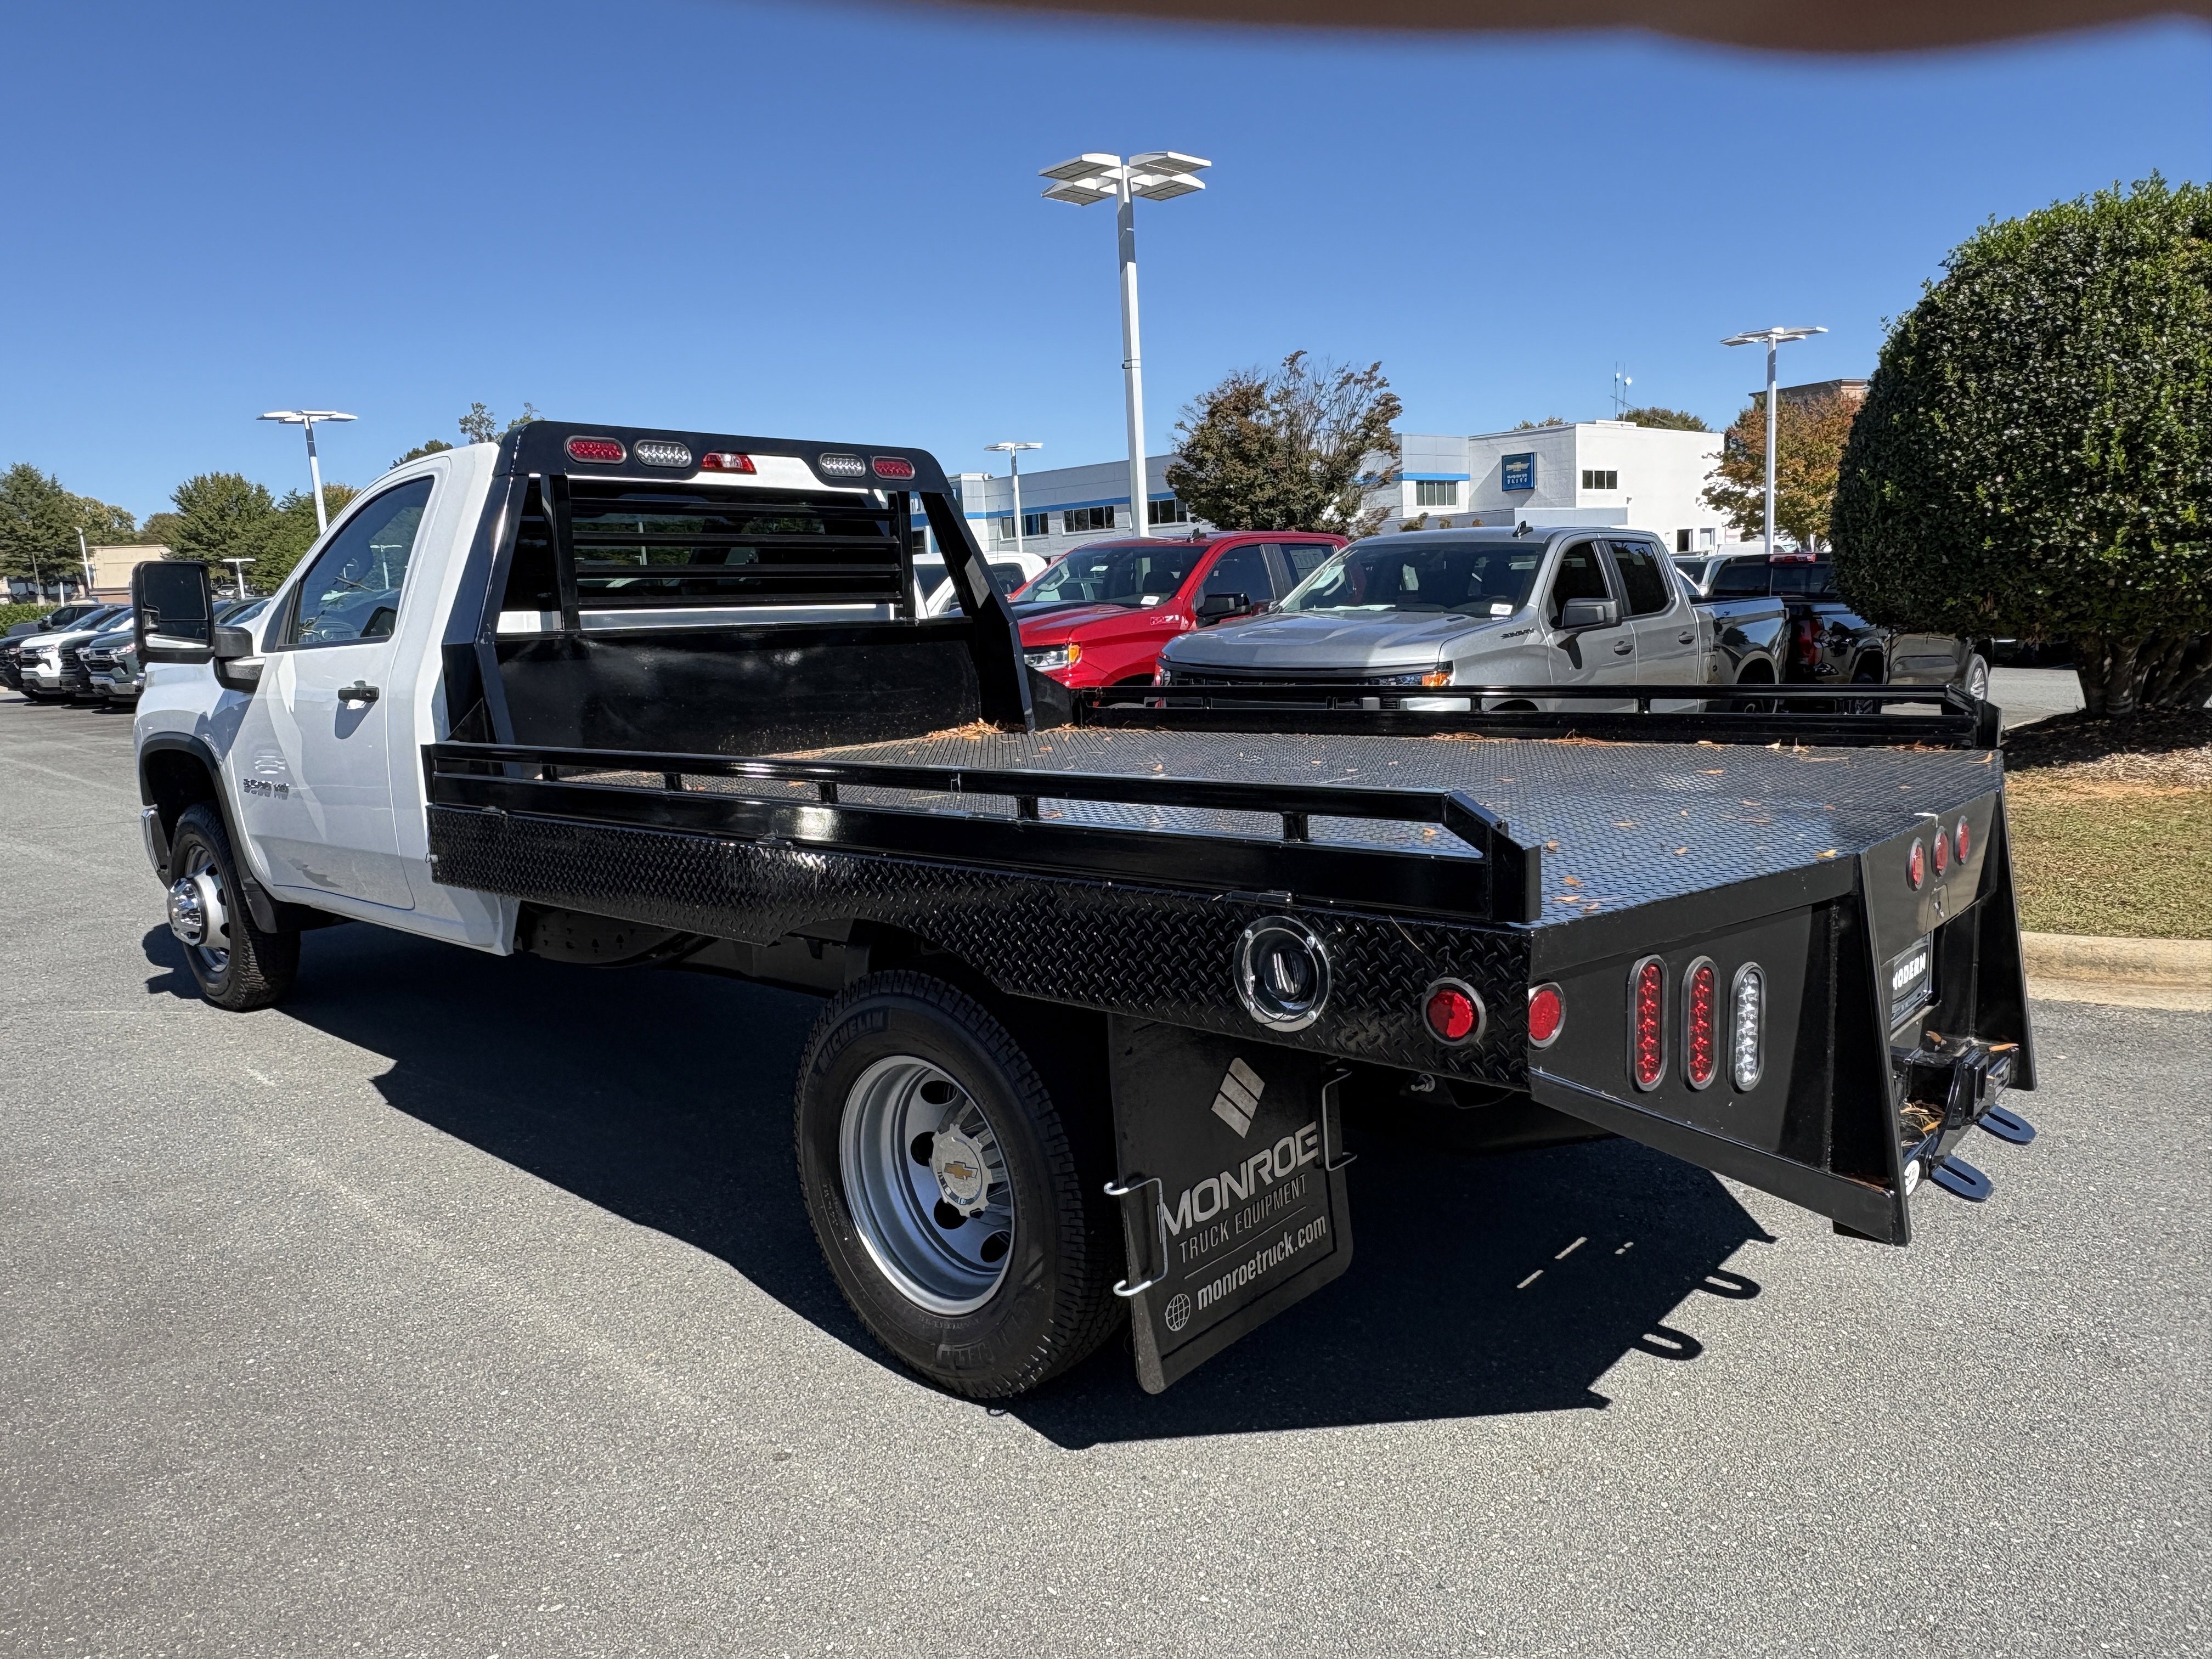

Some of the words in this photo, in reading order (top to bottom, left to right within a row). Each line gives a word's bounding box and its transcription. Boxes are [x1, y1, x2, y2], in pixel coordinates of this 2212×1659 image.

[1157, 1121, 1319, 1244] MONROE
[1179, 1220, 1229, 1263] TRUCK
[1235, 1174, 1306, 1233] EQUIPMENT
[1197, 1215, 1327, 1310] monroetruck.com
